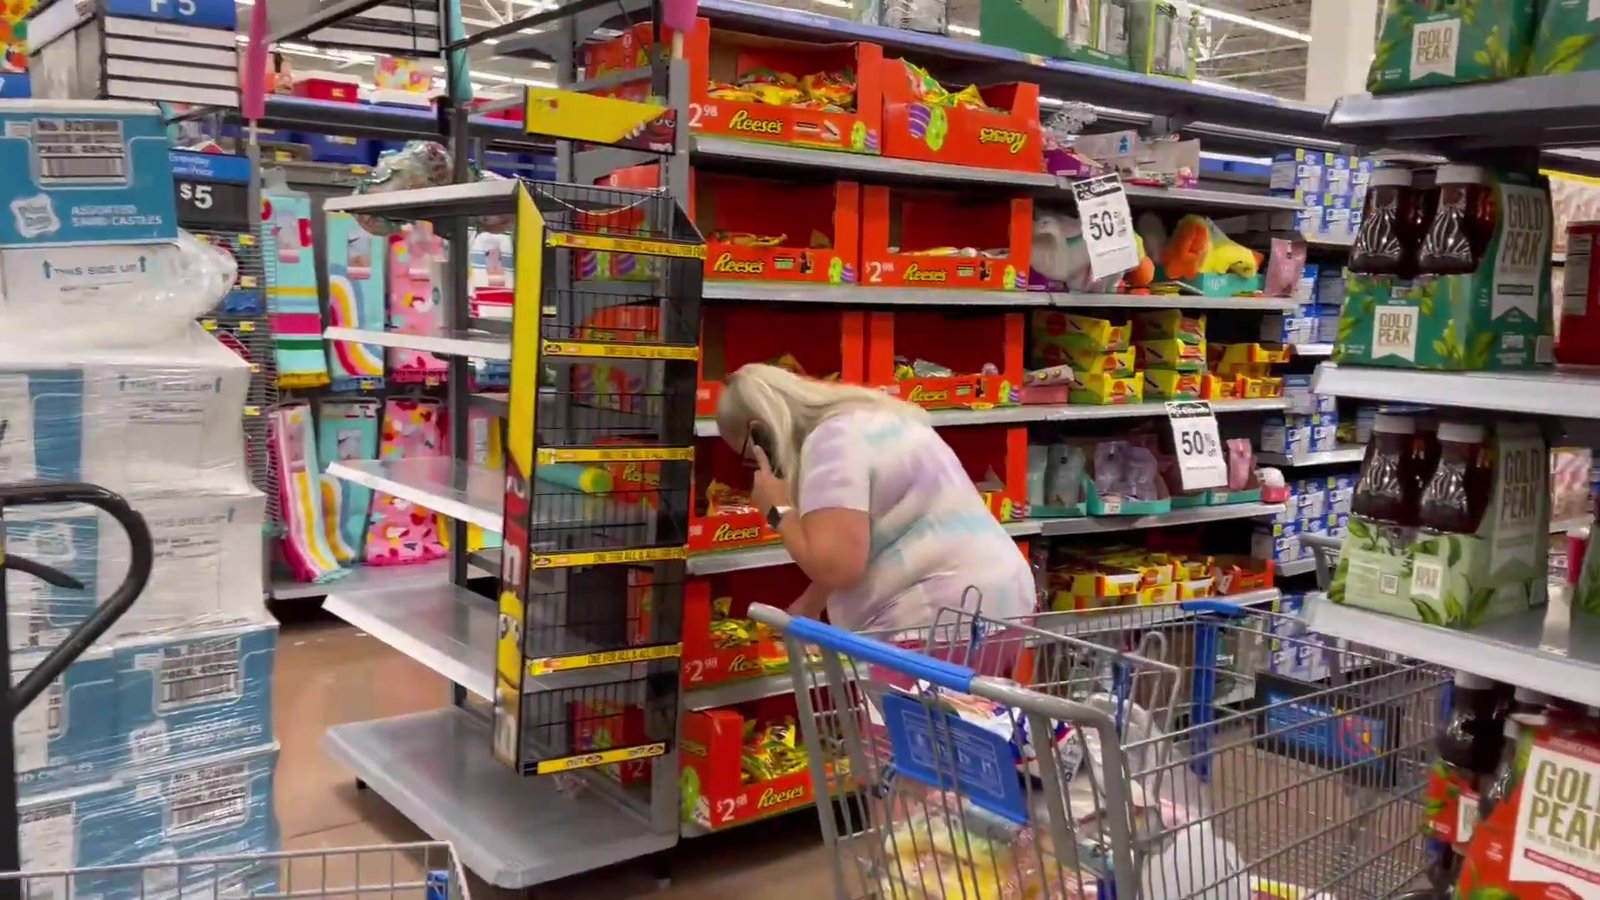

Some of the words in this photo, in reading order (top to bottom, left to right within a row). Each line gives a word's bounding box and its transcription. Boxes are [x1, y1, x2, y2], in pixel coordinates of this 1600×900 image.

[1417, 27, 1453, 46] GOLD
[1416, 45, 1450, 63] PEAK
[179, 183, 213, 210] $5
[1506, 193, 1544, 230] GOLD
[1501, 231, 1542, 266] PEAK
[1379, 313, 1413, 329] GOLD
[1378, 328, 1411, 346] PEAK
[1505, 448, 1541, 484] GOLD
[1501, 483, 1537, 521] PEAK
[1534, 758, 1600, 812] GOL
